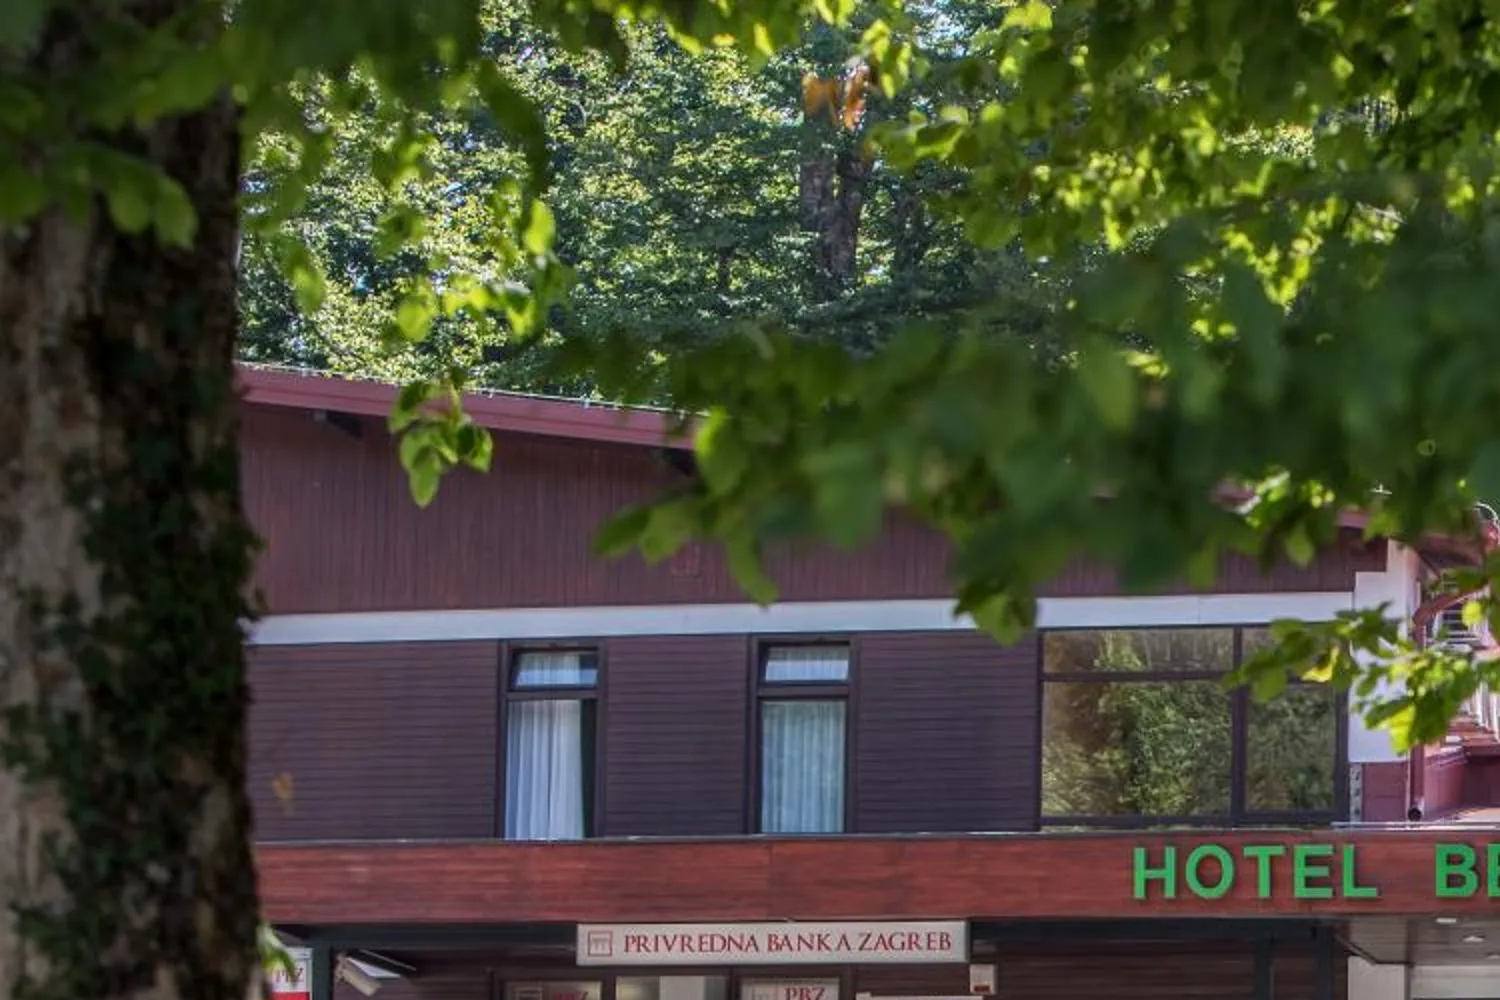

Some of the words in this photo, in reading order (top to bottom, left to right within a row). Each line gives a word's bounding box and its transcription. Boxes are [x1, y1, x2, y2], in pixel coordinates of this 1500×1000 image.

[1132, 843, 1379, 899] HOTEL
[623, 933, 760, 953] PRIVREDNA
[767, 932, 852, 953] BANKA
[858, 931, 952, 952] ZAGREB
